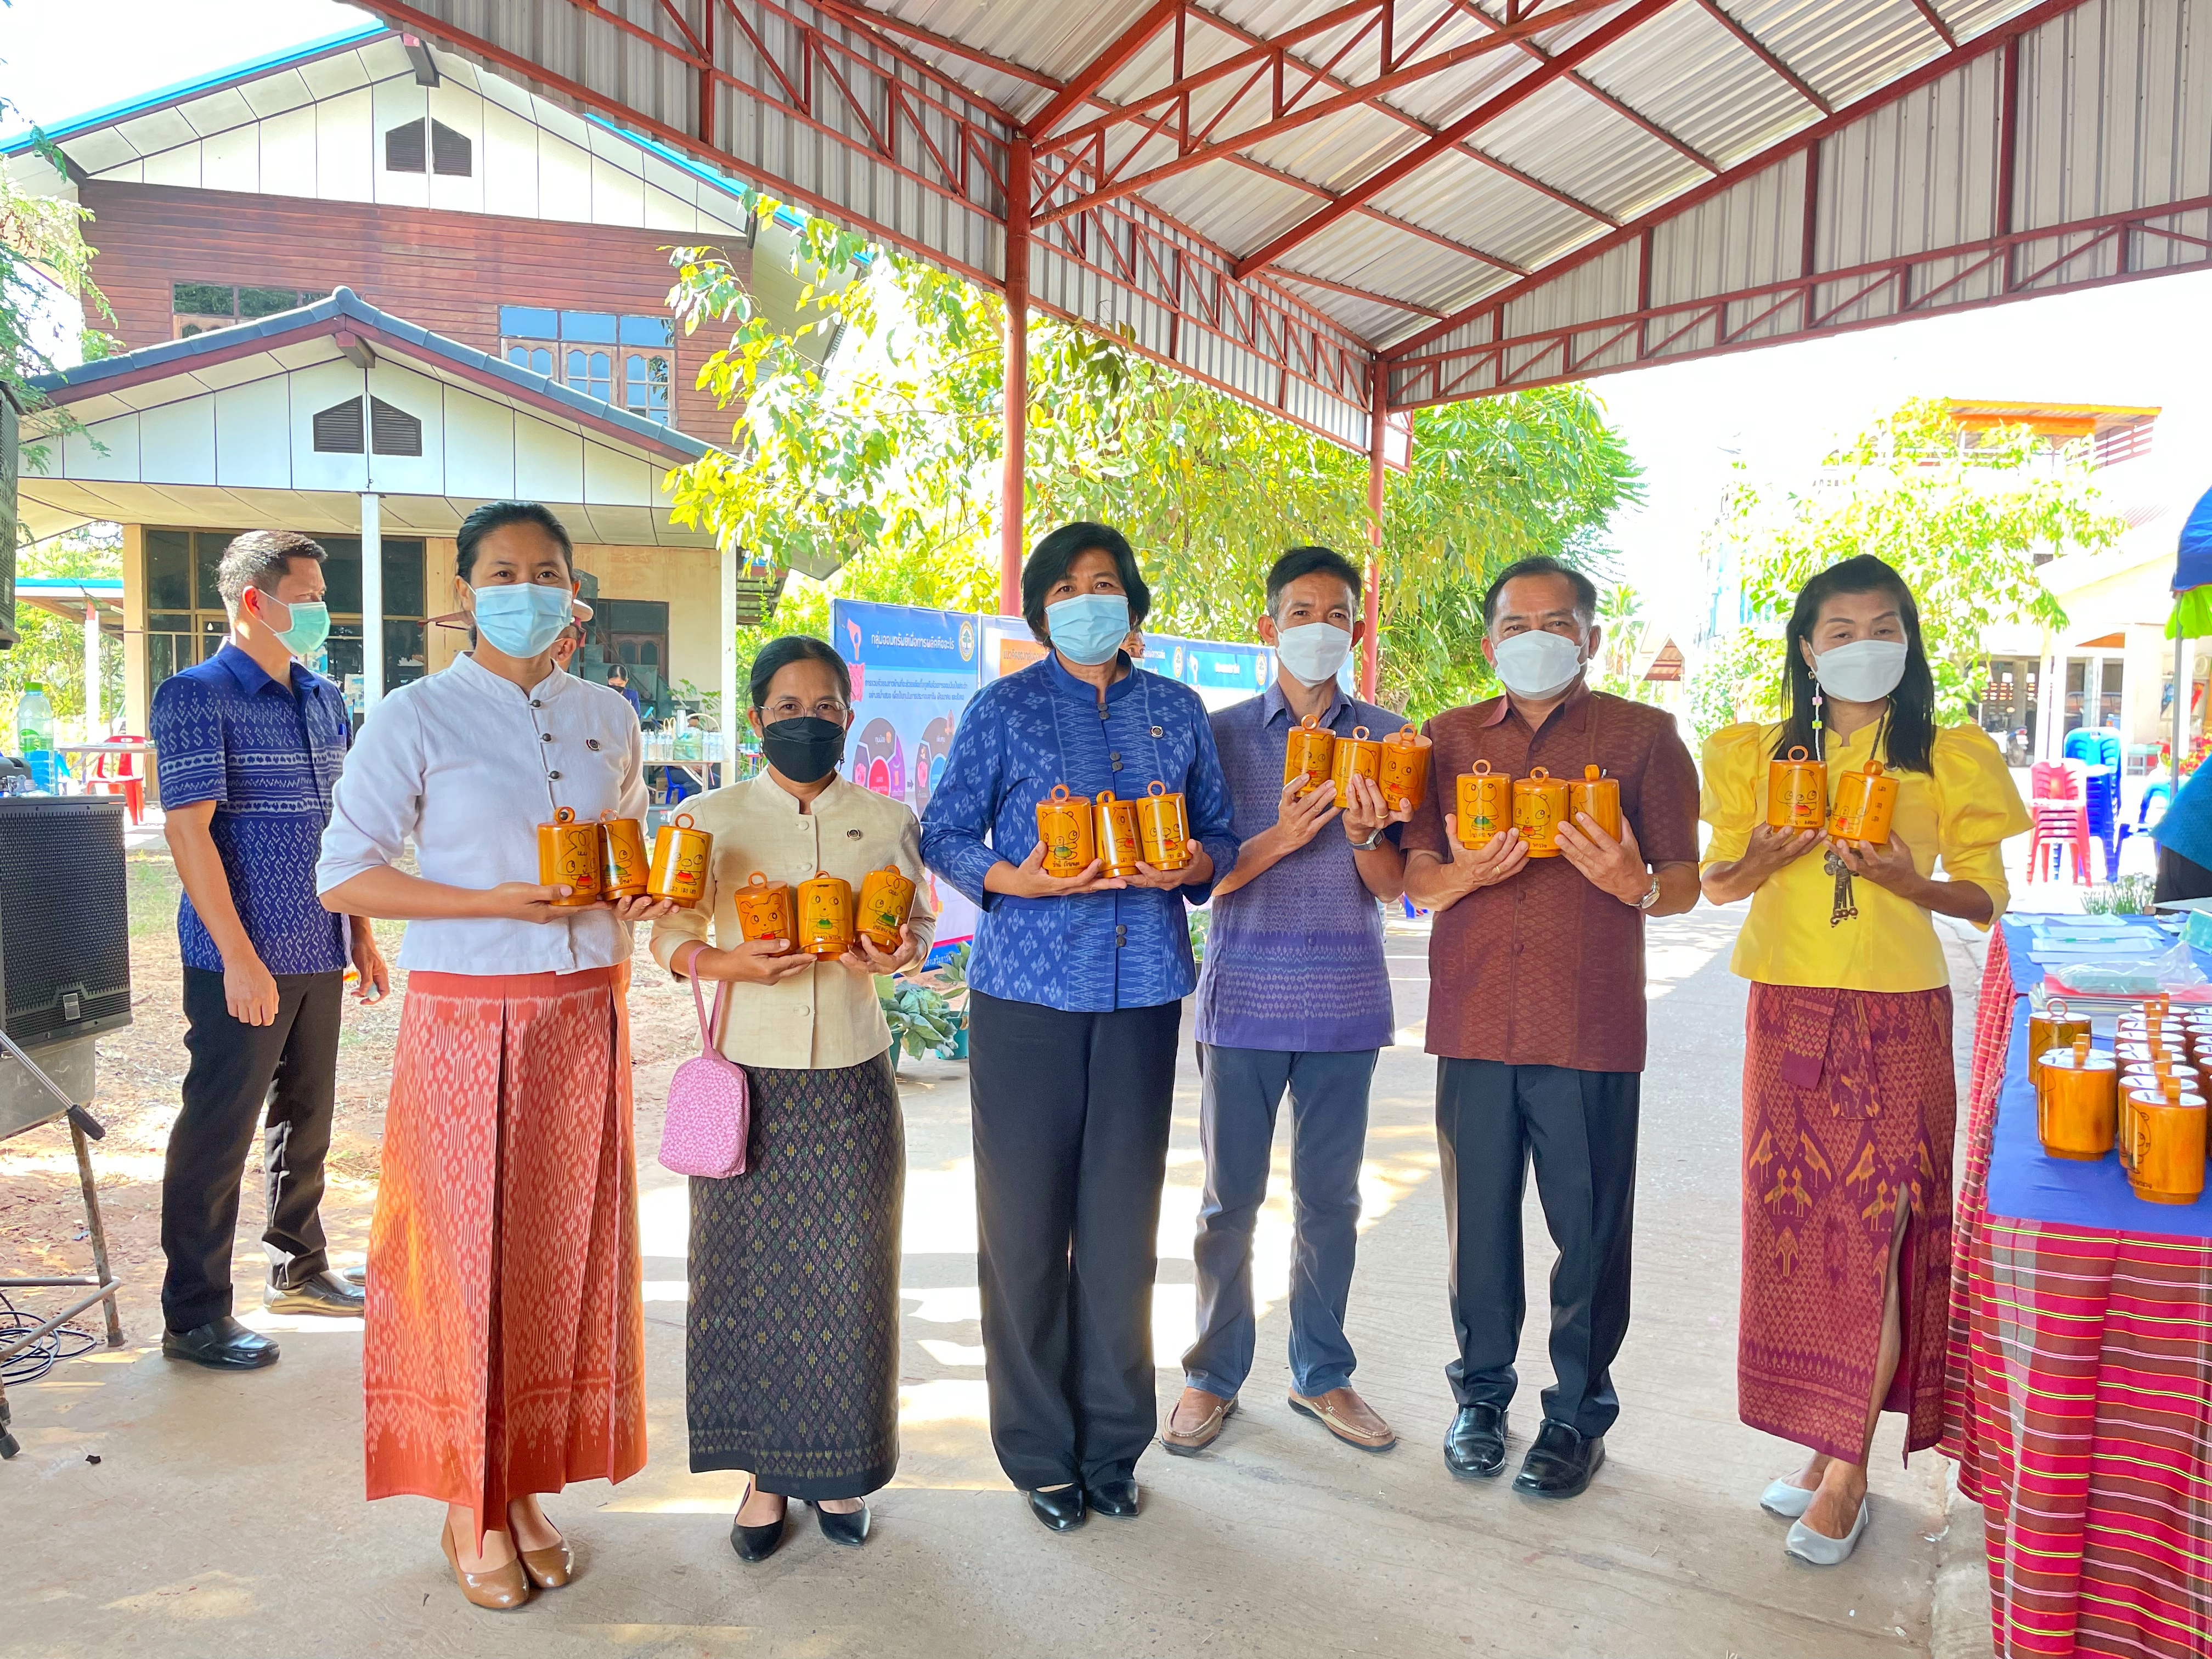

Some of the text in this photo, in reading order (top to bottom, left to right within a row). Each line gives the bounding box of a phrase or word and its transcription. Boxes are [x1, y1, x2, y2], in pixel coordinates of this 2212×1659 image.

[871, 630, 955, 650] กลุ่มออมทรัพย์เพื่อการผลิตคืออะไร
